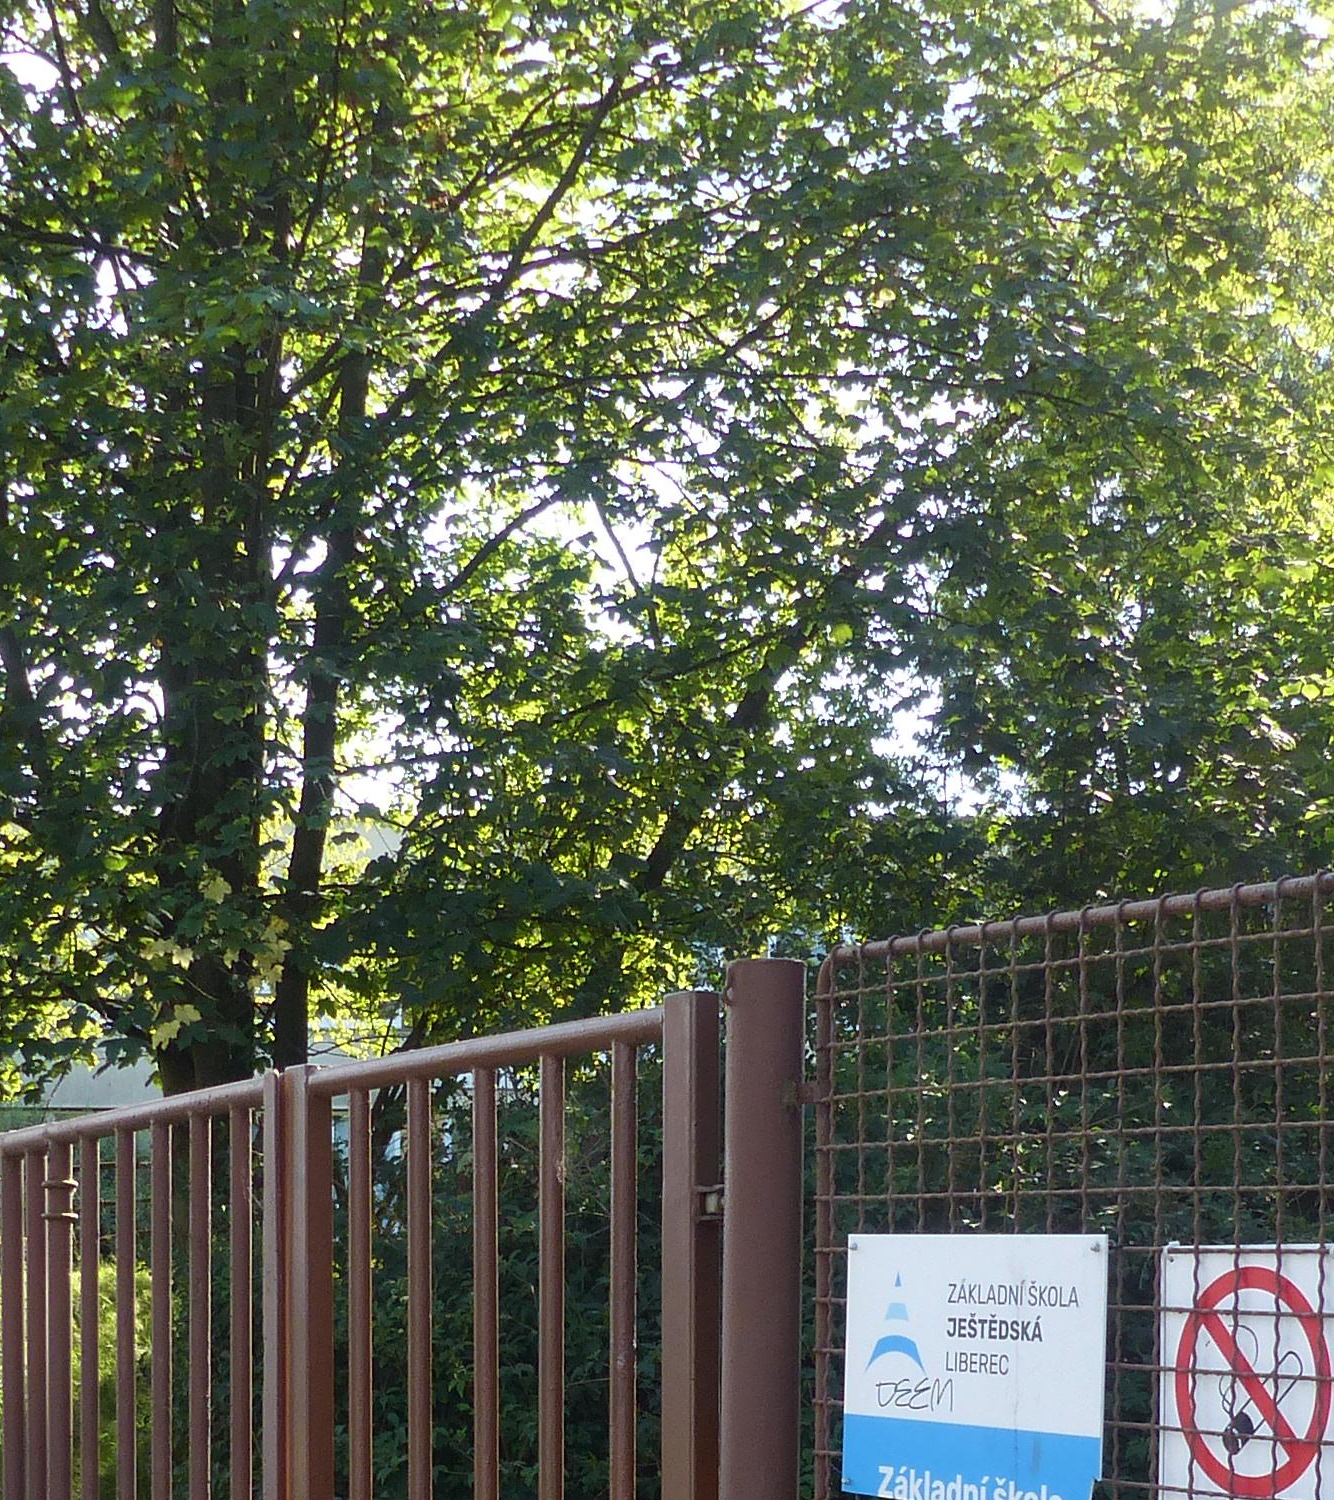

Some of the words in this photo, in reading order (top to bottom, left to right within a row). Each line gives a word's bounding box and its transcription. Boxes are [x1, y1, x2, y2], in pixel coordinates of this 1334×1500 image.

[947, 1279, 1025, 1307] ZÁKLADNÍ
[1028, 1281, 1080, 1308] ŠKOLA
[946, 1313, 1043, 1342] JEŠTĚDSKÁ
[945, 1351, 1010, 1376] LIBEREC
